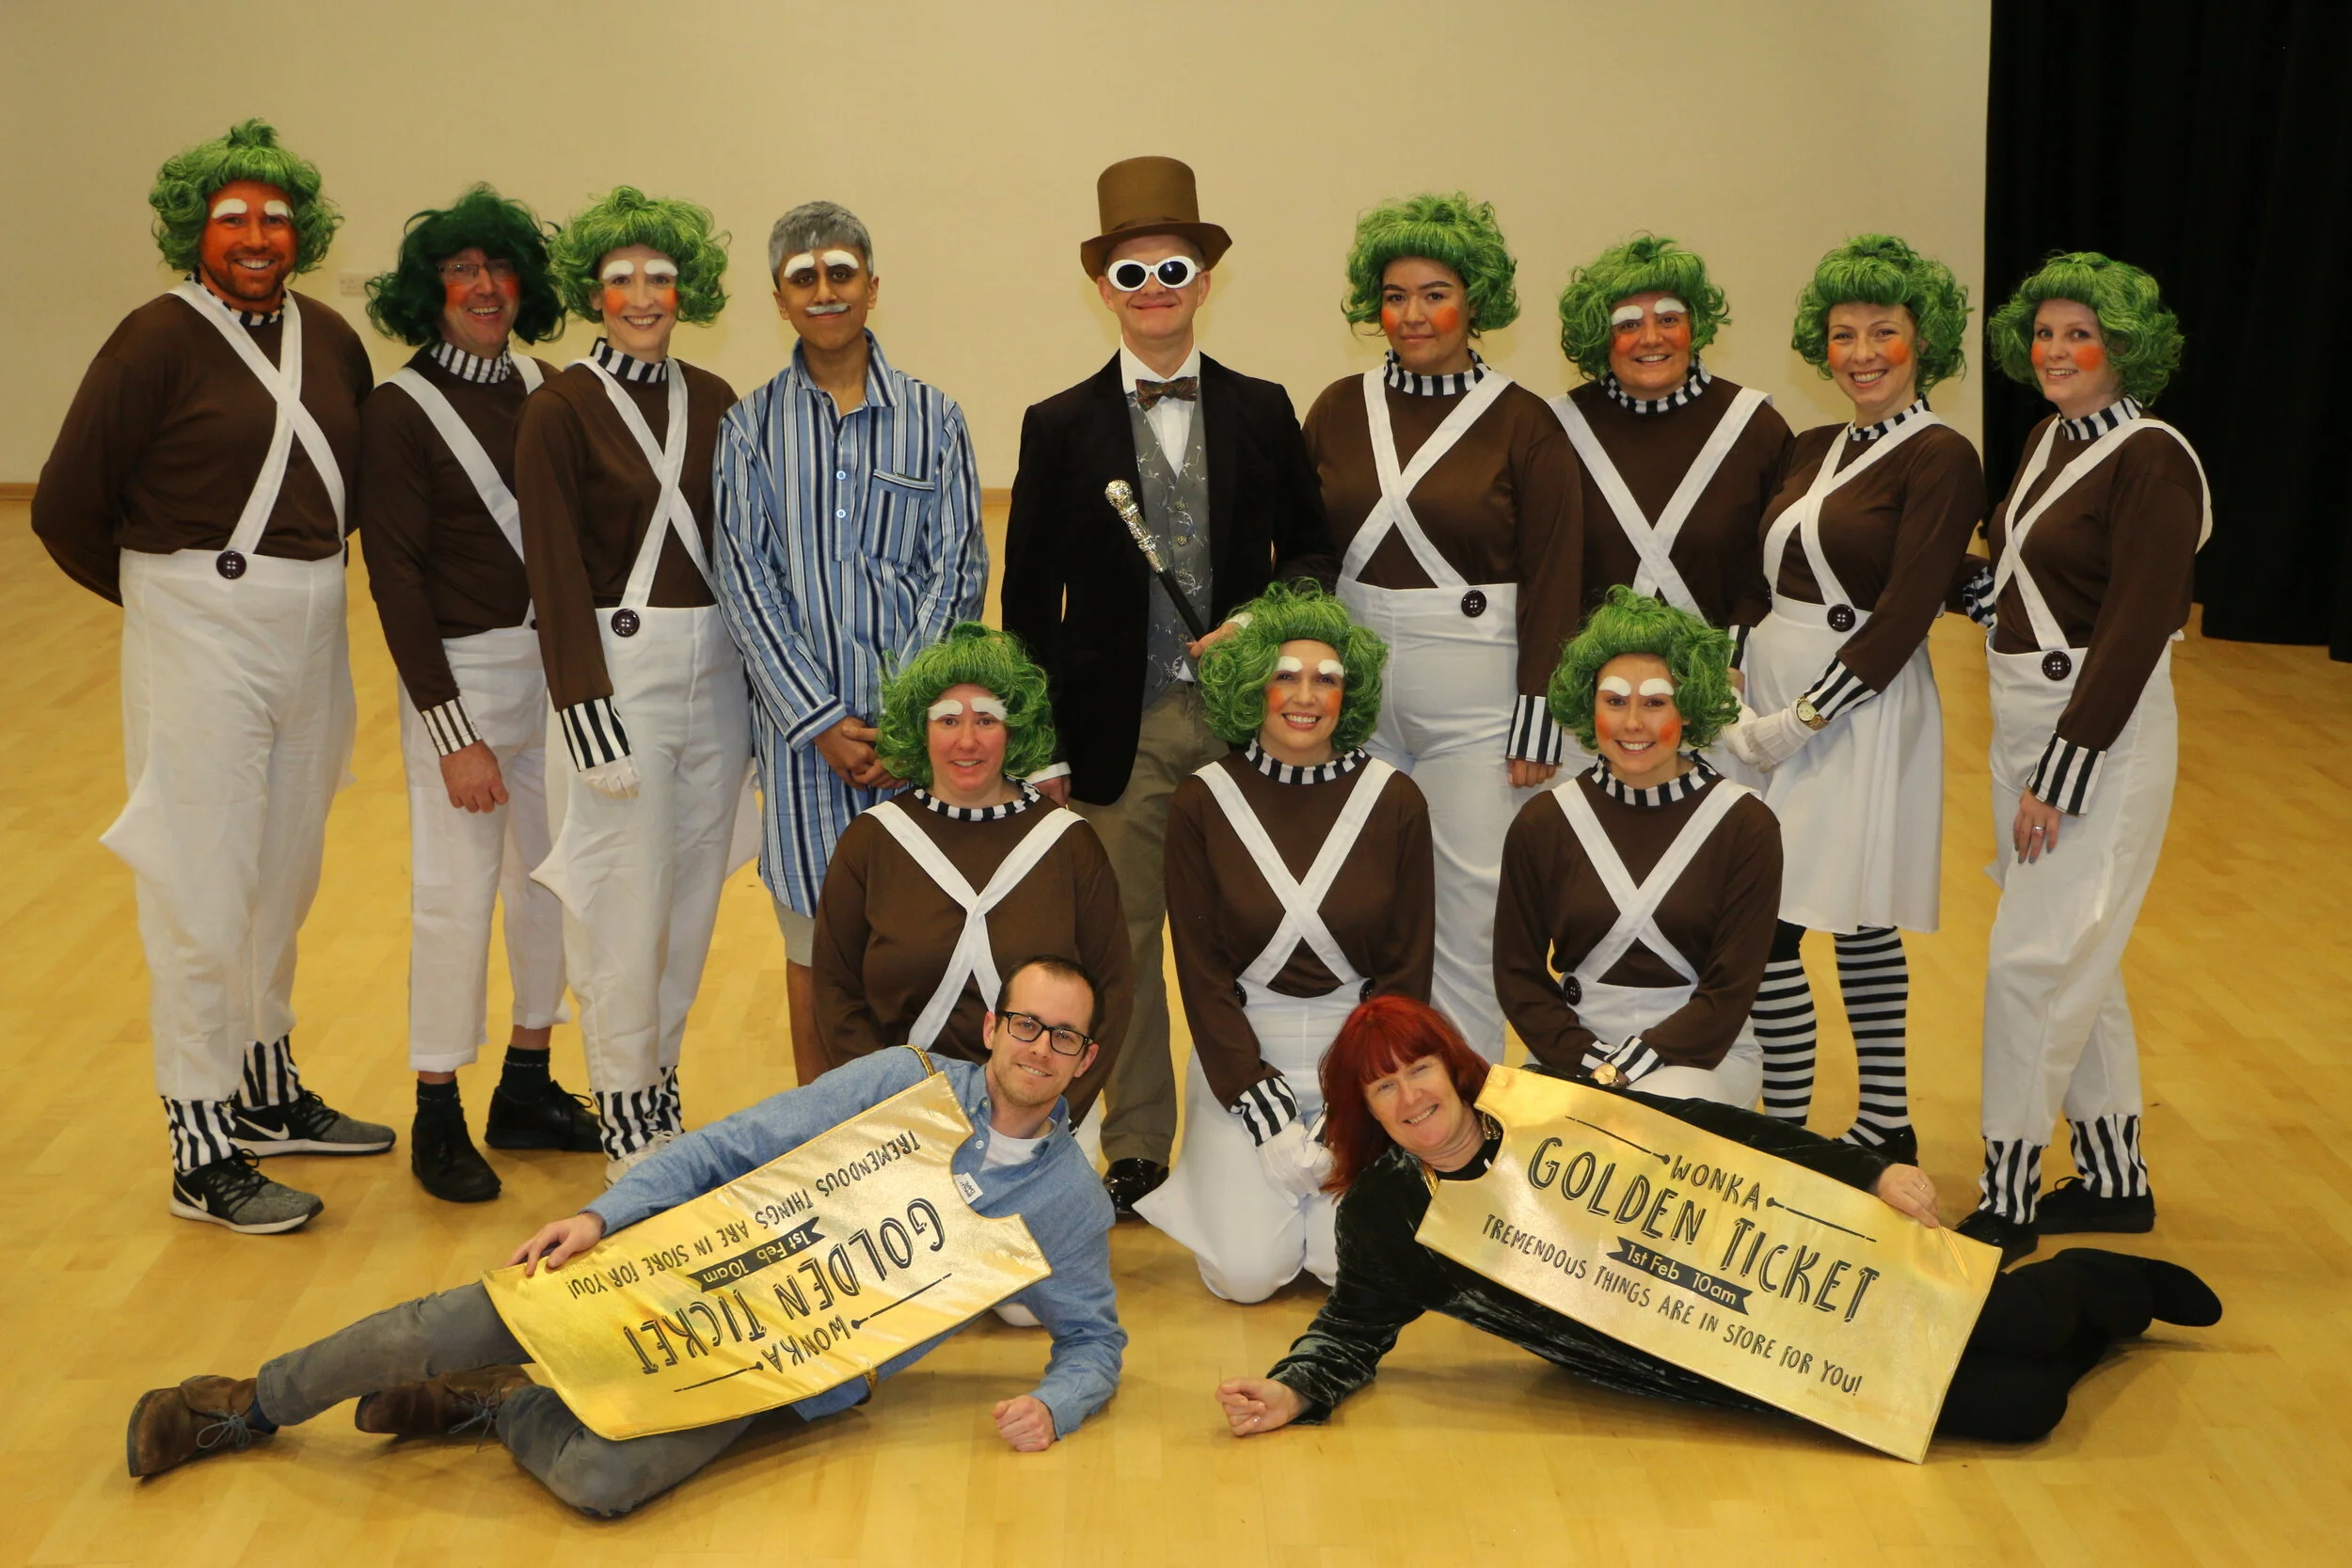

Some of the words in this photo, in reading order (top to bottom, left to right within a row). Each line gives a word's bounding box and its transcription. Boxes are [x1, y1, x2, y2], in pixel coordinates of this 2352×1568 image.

[816, 1130, 921, 1196] TREMENDOUS
[1670, 1155, 1759, 1212] WONKA
[755, 1188, 814, 1229] THINGS
[694, 1235, 714, 1257] IN
[716, 1220, 749, 1247] ARE
[787, 1229, 812, 1250] 1st
[1528, 1136, 1707, 1245] GOLDEN
[1720, 1217, 1881, 1323] TICKET
[608, 1261, 641, 1287] FOR
[643, 1244, 690, 1276] STORE
[703, 1259, 750, 1283] 10am
[756, 1242, 788, 1265] Feb
[773, 1197, 946, 1321] GOLDEN
[1626, 1243, 1649, 1266] 1st
[1652, 1254, 1680, 1281] Feb
[1691, 1272, 1738, 1305] 10am
[565, 1274, 609, 1299] YOU!
[1482, 1213, 1588, 1279] TREMENDOUS
[1593, 1265, 1652, 1307] THINGS
[1657, 1295, 1693, 1325] ARE
[1698, 1311, 1721, 1333] IN
[1722, 1324, 1777, 1359] STORE
[1778, 1345, 1813, 1374] FOR
[1820, 1359, 1864, 1396] YOU!
[623, 1289, 767, 1374] TICKET
[761, 1313, 851, 1373] WONKA
